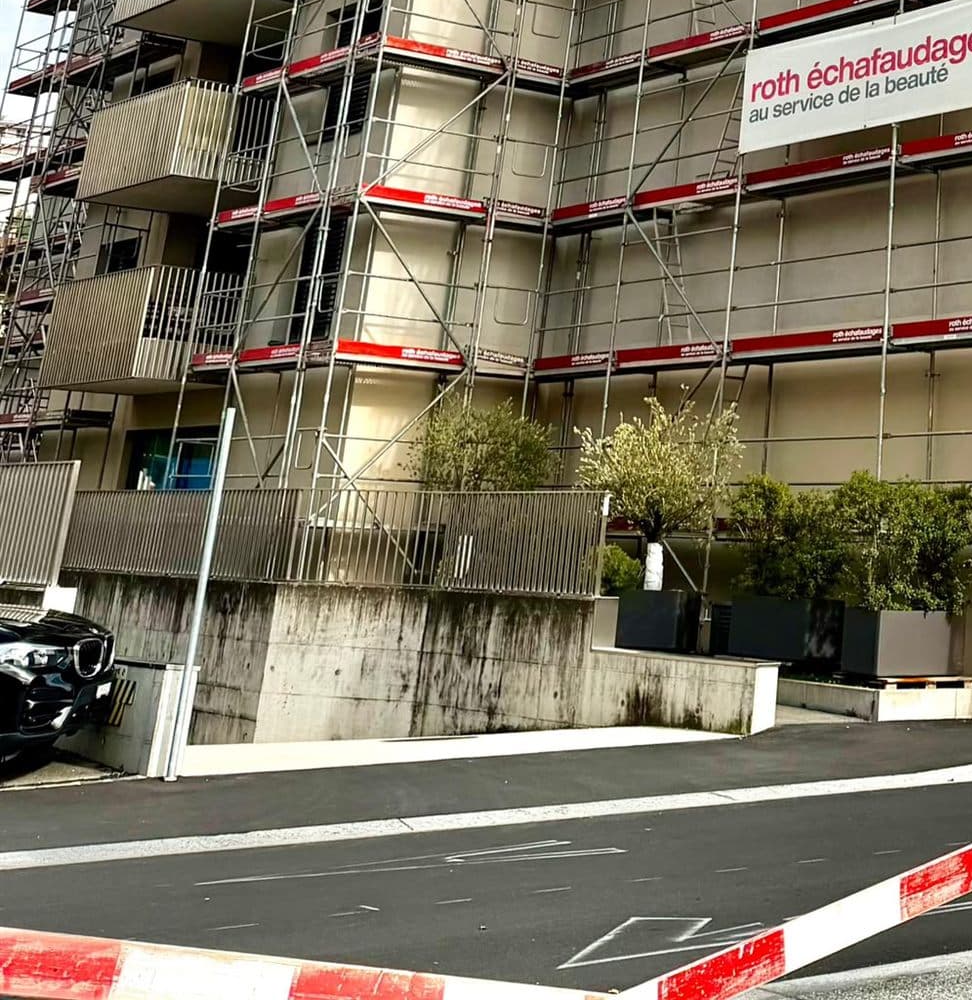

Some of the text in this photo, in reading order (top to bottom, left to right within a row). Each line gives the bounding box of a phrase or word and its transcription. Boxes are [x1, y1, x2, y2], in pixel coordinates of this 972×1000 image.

[749, 62, 949, 123] au service de la beauté
[751, 69, 800, 103] roth
